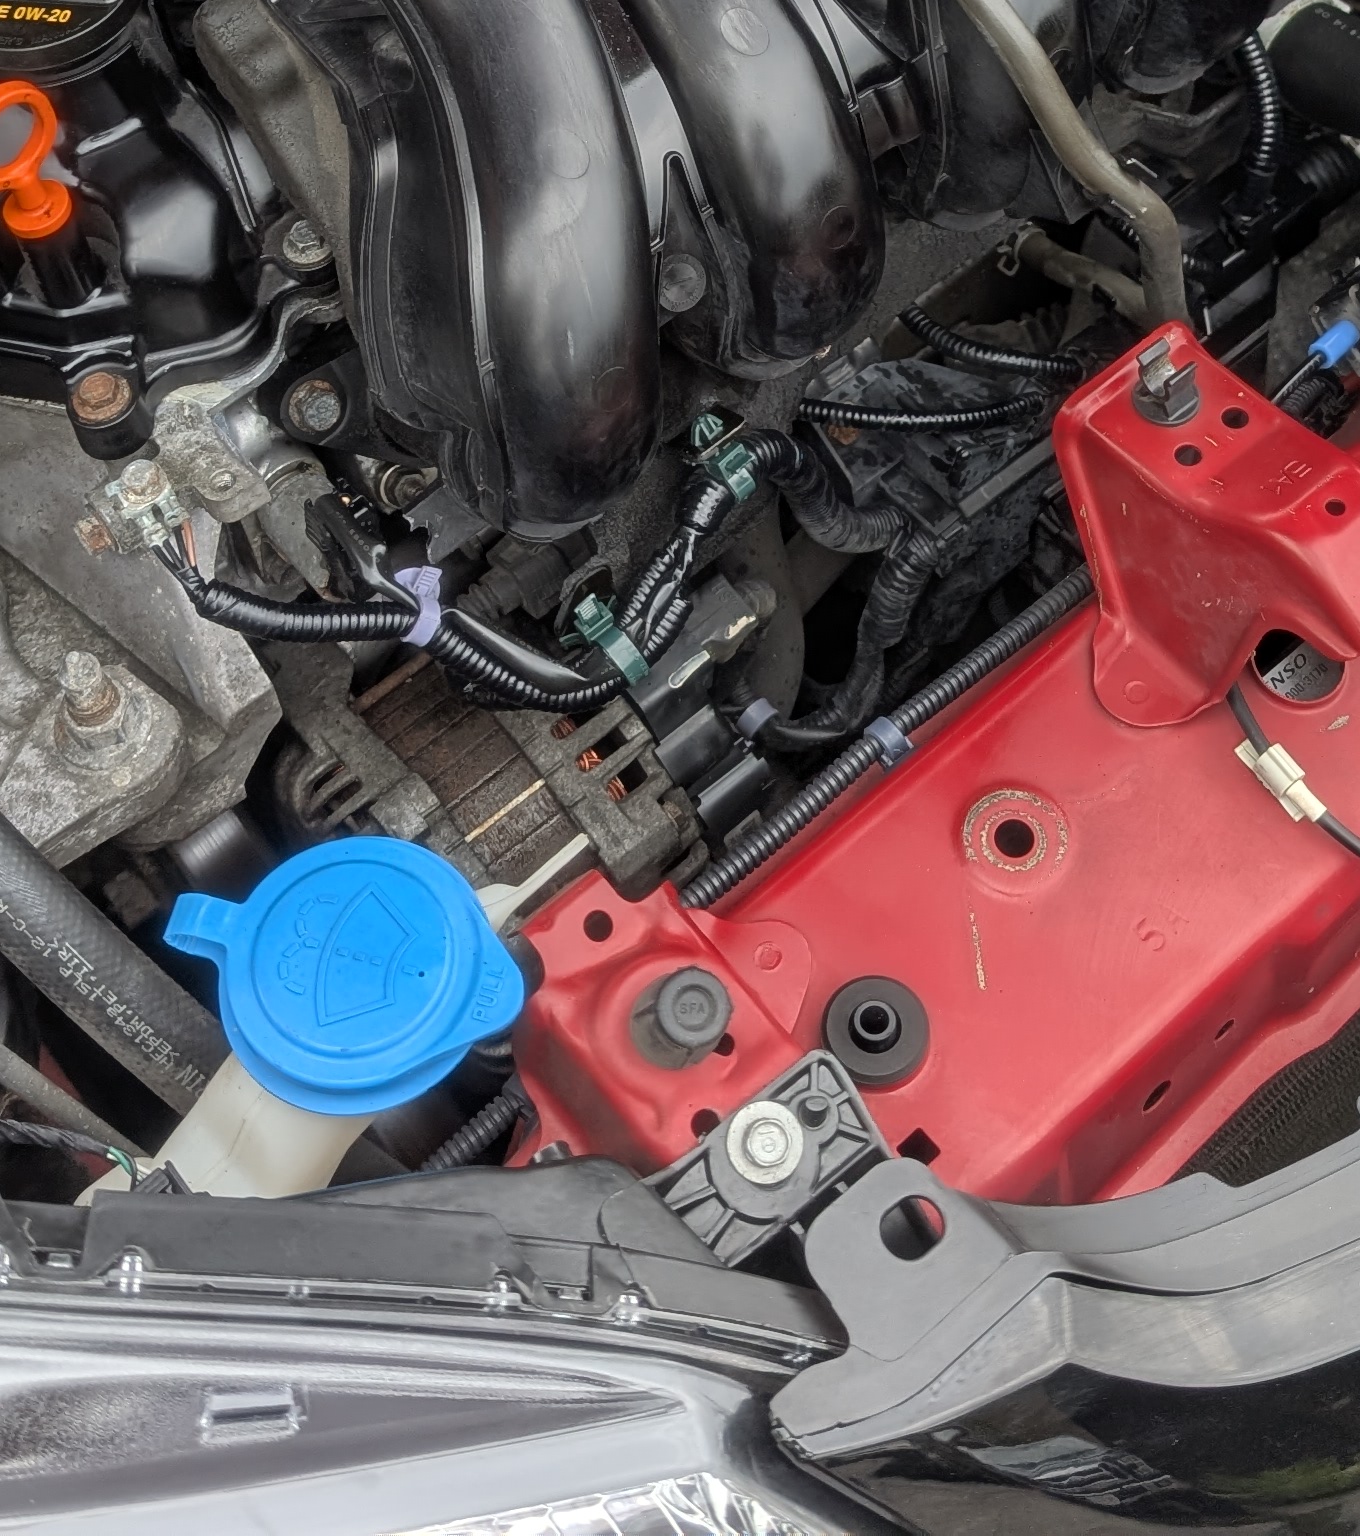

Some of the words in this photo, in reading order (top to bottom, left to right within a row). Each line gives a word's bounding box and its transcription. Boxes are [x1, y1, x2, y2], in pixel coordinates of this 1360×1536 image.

[13, 7, 72, 23] 0W-20
[1270, 652, 1307, 690] NSO
[59, 964, 98, 1005] 15LP
[471, 965, 507, 1023] PULL
[105, 1006, 174, 1074] HFC134a
